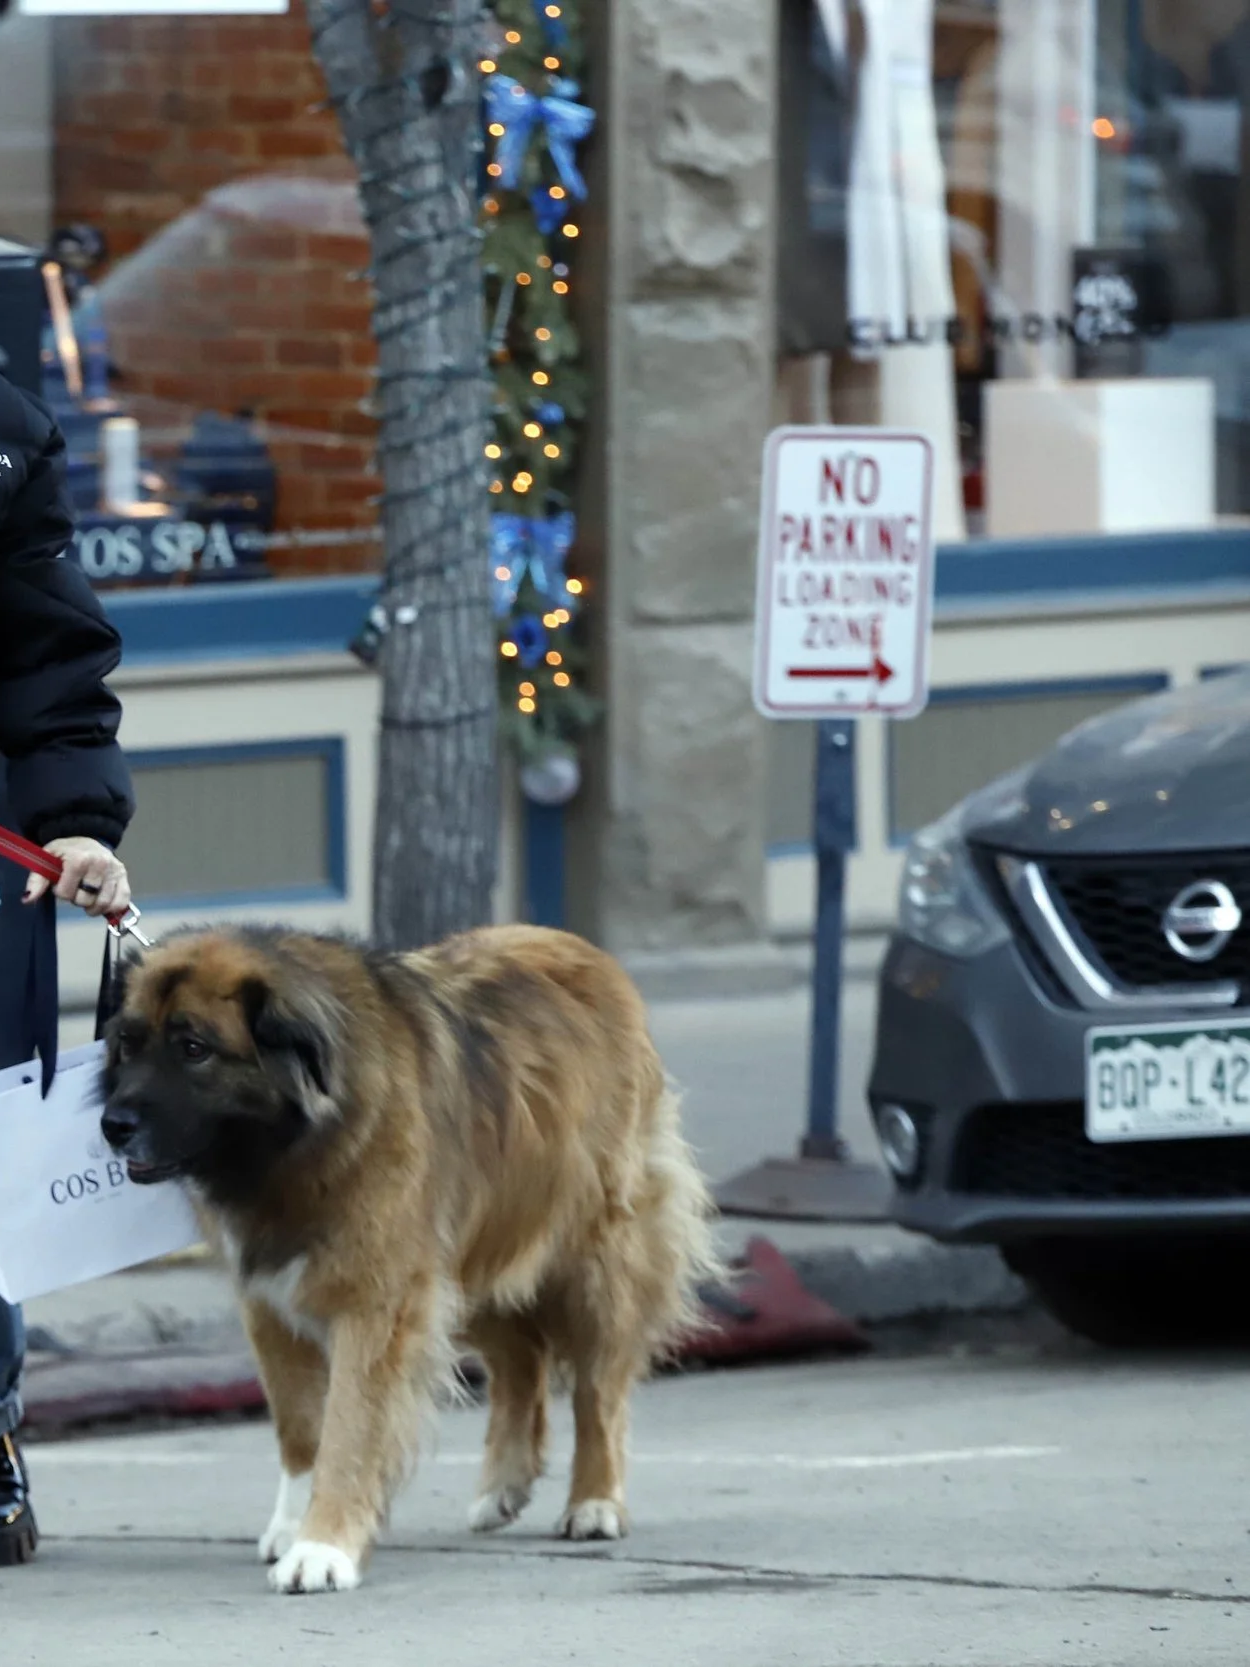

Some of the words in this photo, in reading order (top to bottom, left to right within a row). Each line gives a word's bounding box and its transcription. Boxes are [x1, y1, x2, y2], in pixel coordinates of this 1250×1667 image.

[820, 455, 881, 507] NO
[71, 525, 144, 578] OS
[150, 521, 237, 573] SPA
[776, 513, 920, 563] PARKING
[777, 570, 913, 609] LOADING
[803, 612, 884, 650] ZONE
[50, 1168, 100, 1205] COS
